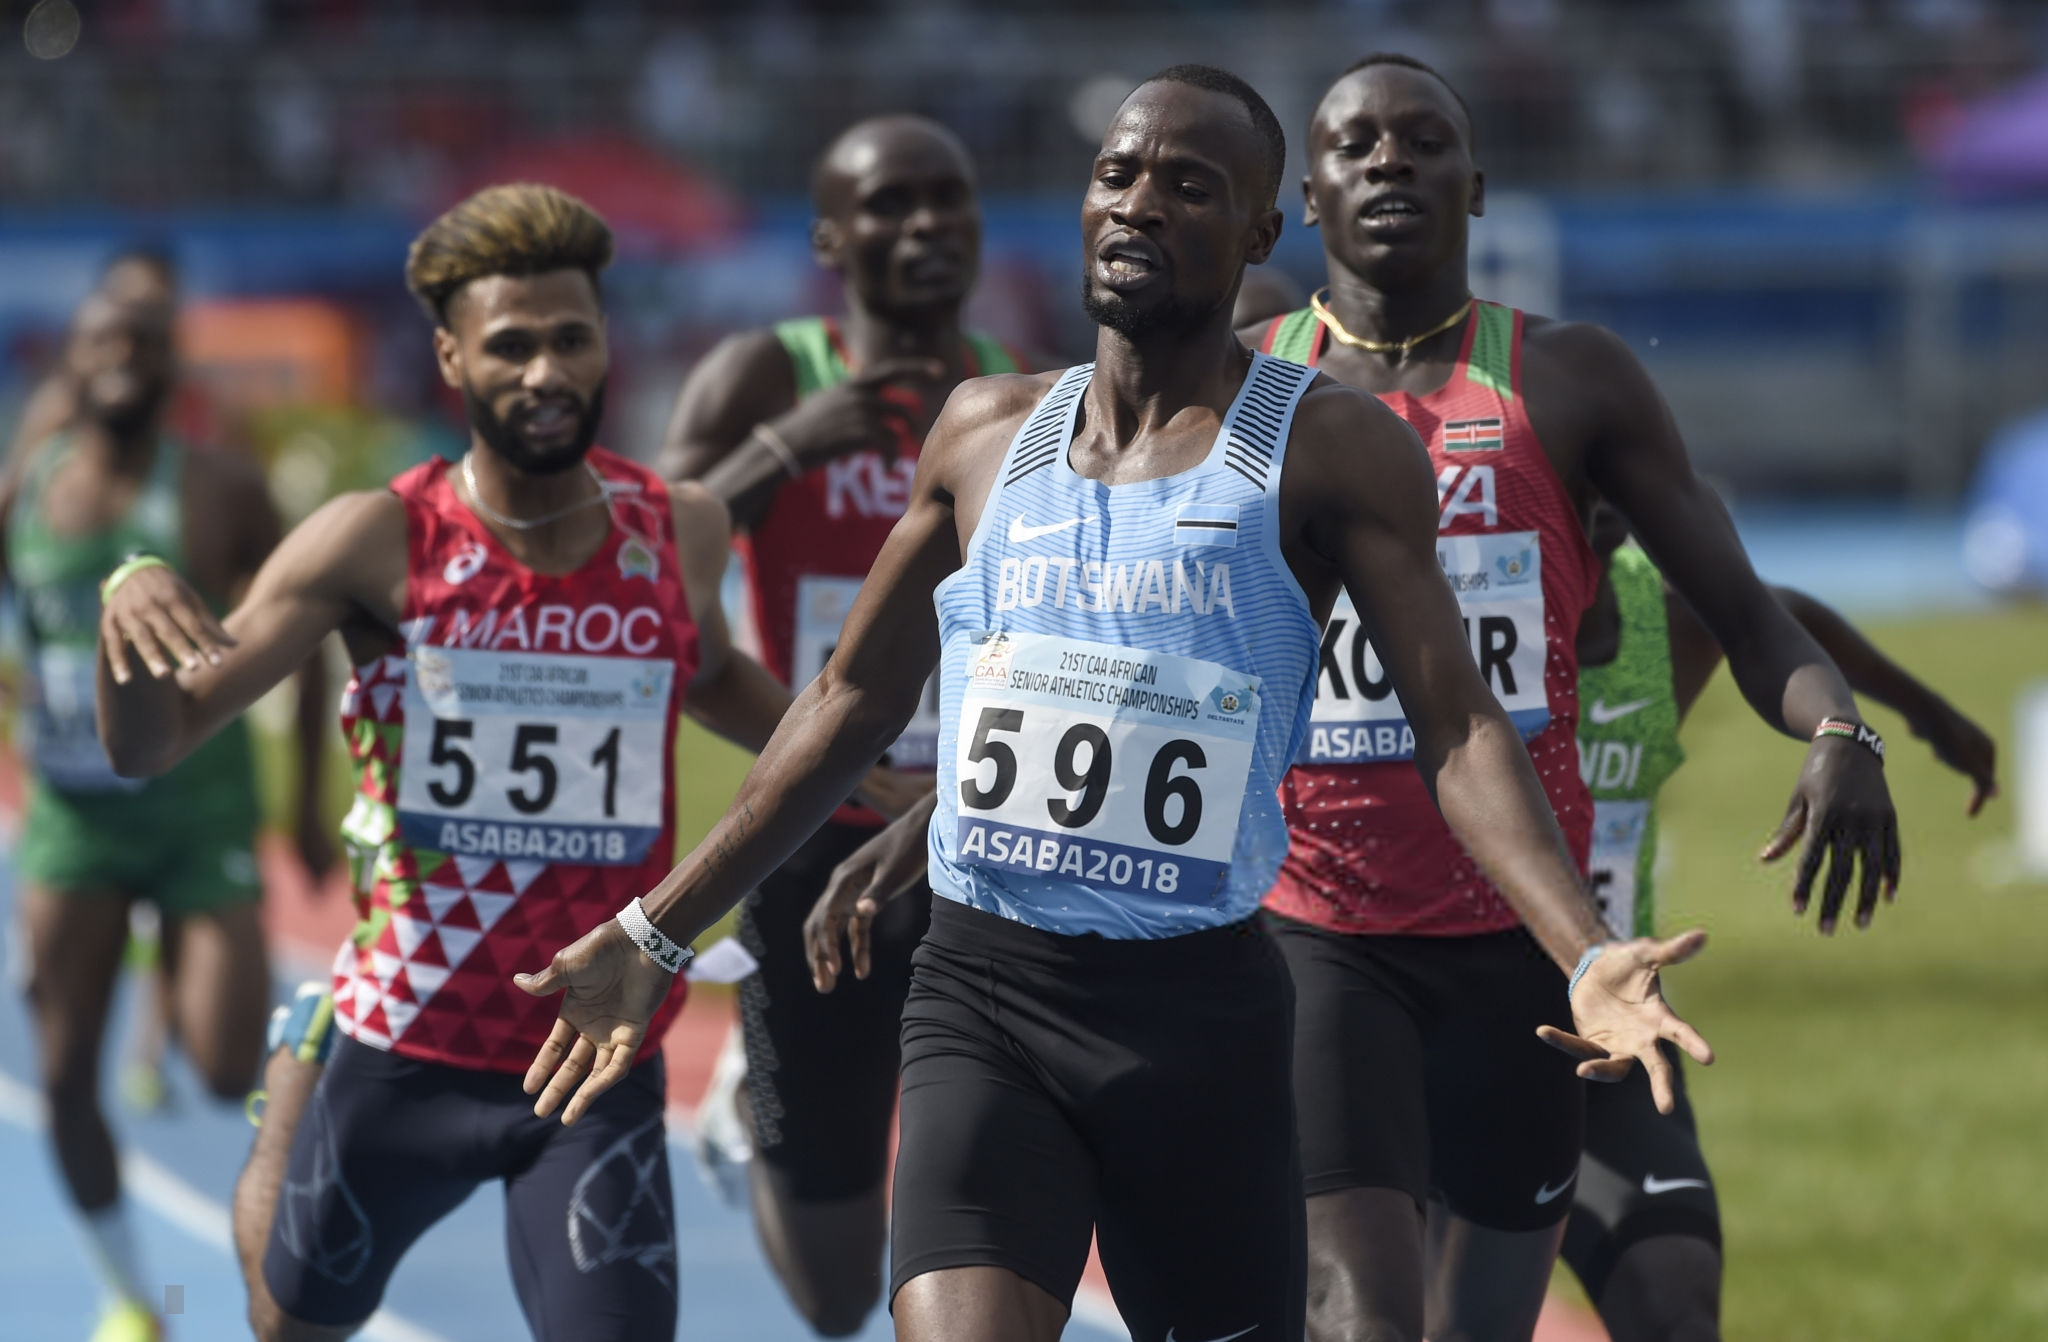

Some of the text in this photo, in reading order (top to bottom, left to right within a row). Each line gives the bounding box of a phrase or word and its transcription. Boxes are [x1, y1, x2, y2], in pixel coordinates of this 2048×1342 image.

[995, 556, 1236, 618] BOTSWANA
[443, 603, 662, 654] MAROC
[975, 665, 1007, 679] CAA
[1059, 651, 1158, 686] 21ST CAA AFRICAN
[1314, 615, 1519, 701] KOR
[1010, 669, 1200, 720] SENIOR ATHLETICS CHAMPIONSHIPS
[427, 717, 622, 818] 551
[960, 706, 1208, 847] 596
[439, 822, 626, 861] ASABA2018
[960, 826, 1181, 894] ASABA2018
